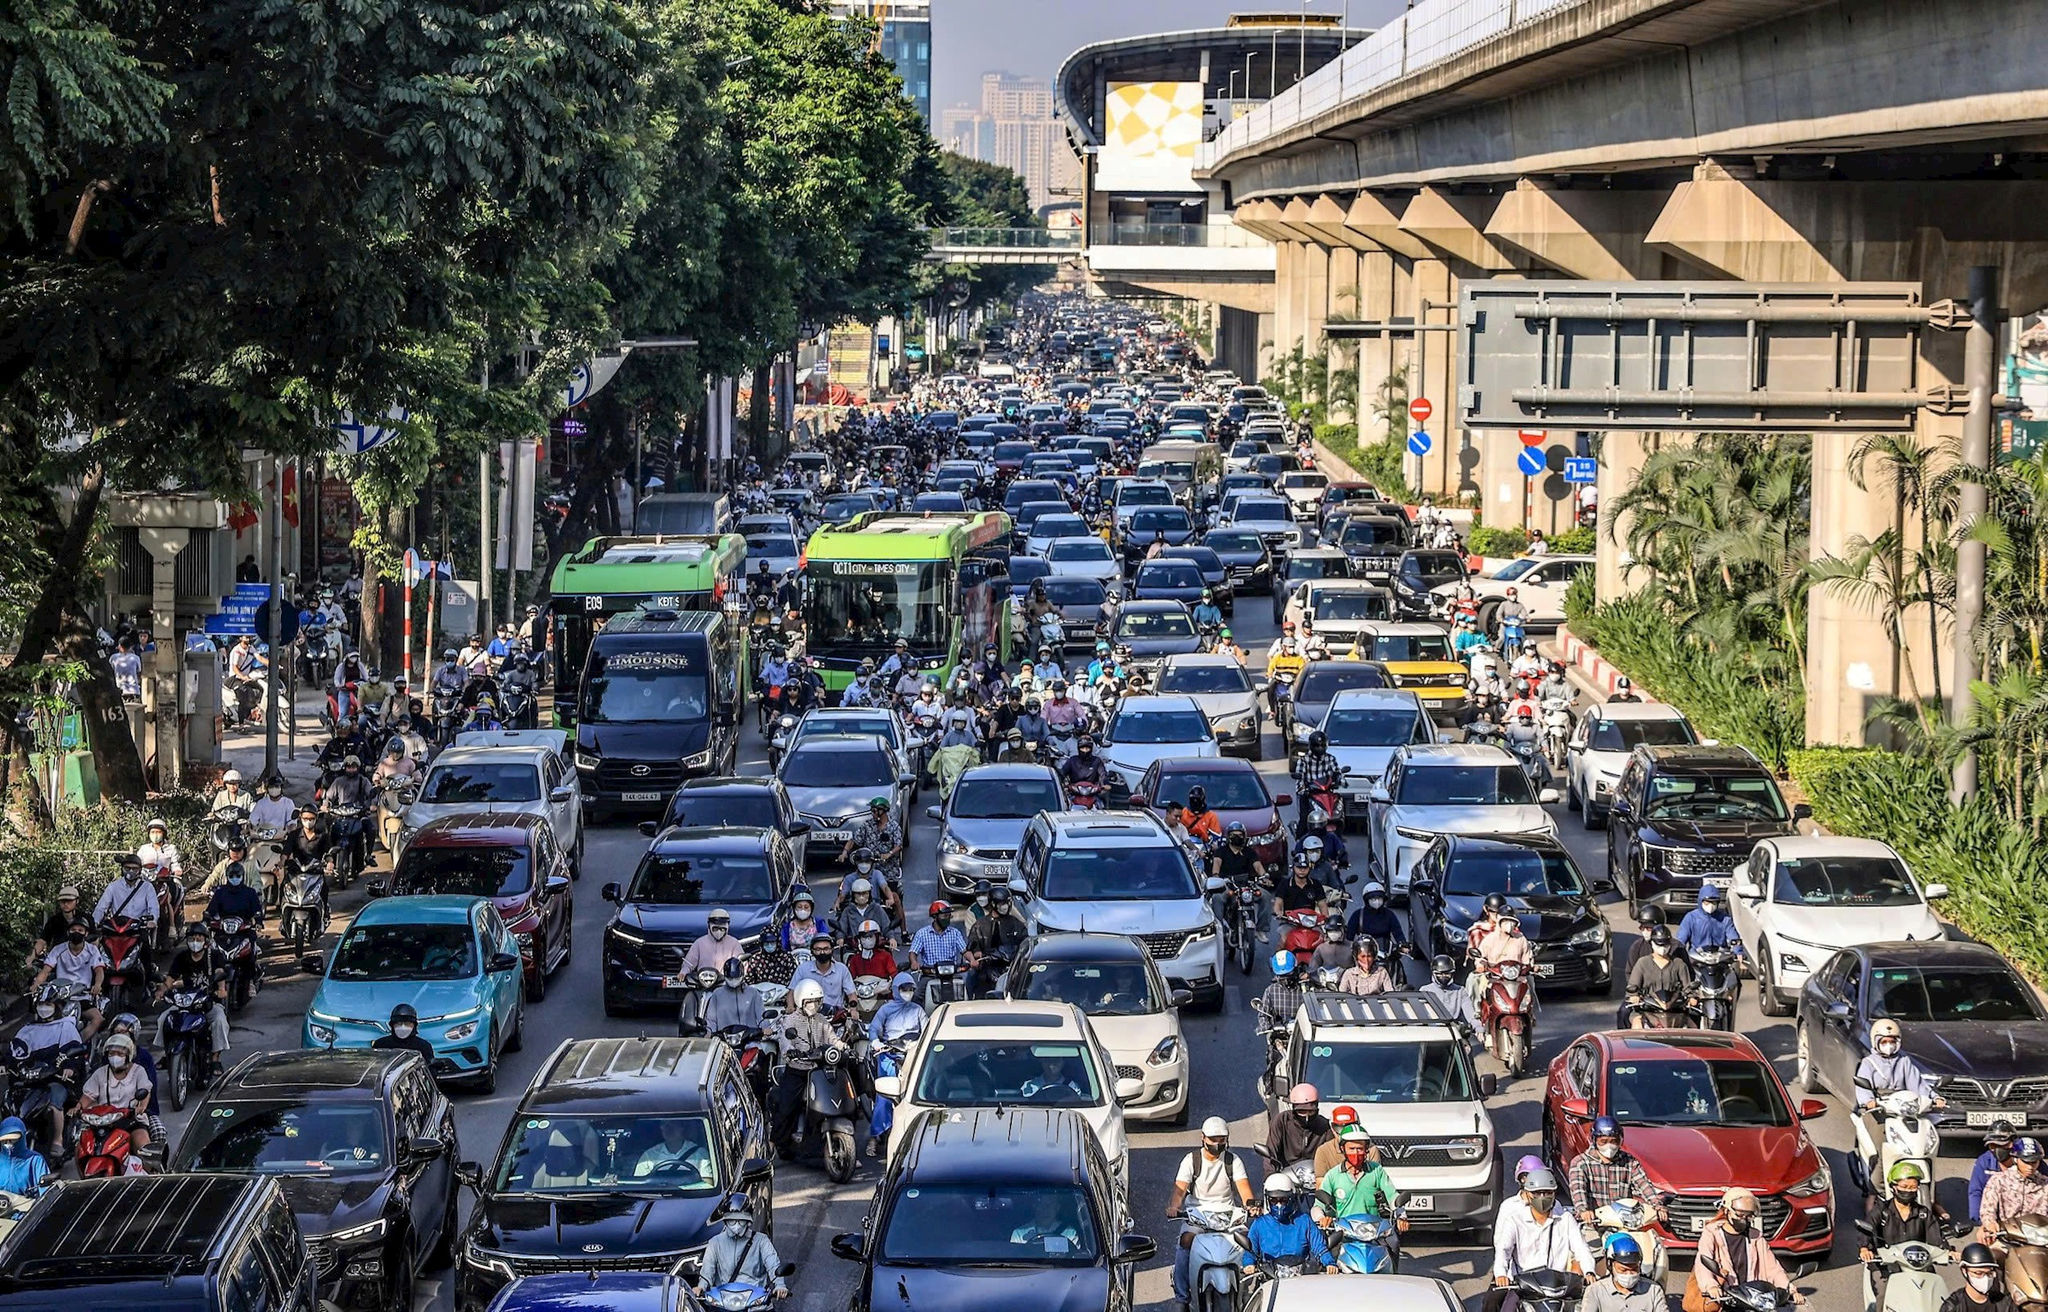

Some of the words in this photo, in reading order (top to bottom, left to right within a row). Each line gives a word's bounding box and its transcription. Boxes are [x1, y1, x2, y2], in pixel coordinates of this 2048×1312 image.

[874, 563, 894, 574] TIMES
[895, 563, 910, 574] CITY
[585, 596, 602, 610] E09
[607, 655, 689, 666] LIMOUSINE
[101, 705, 125, 724] 163
